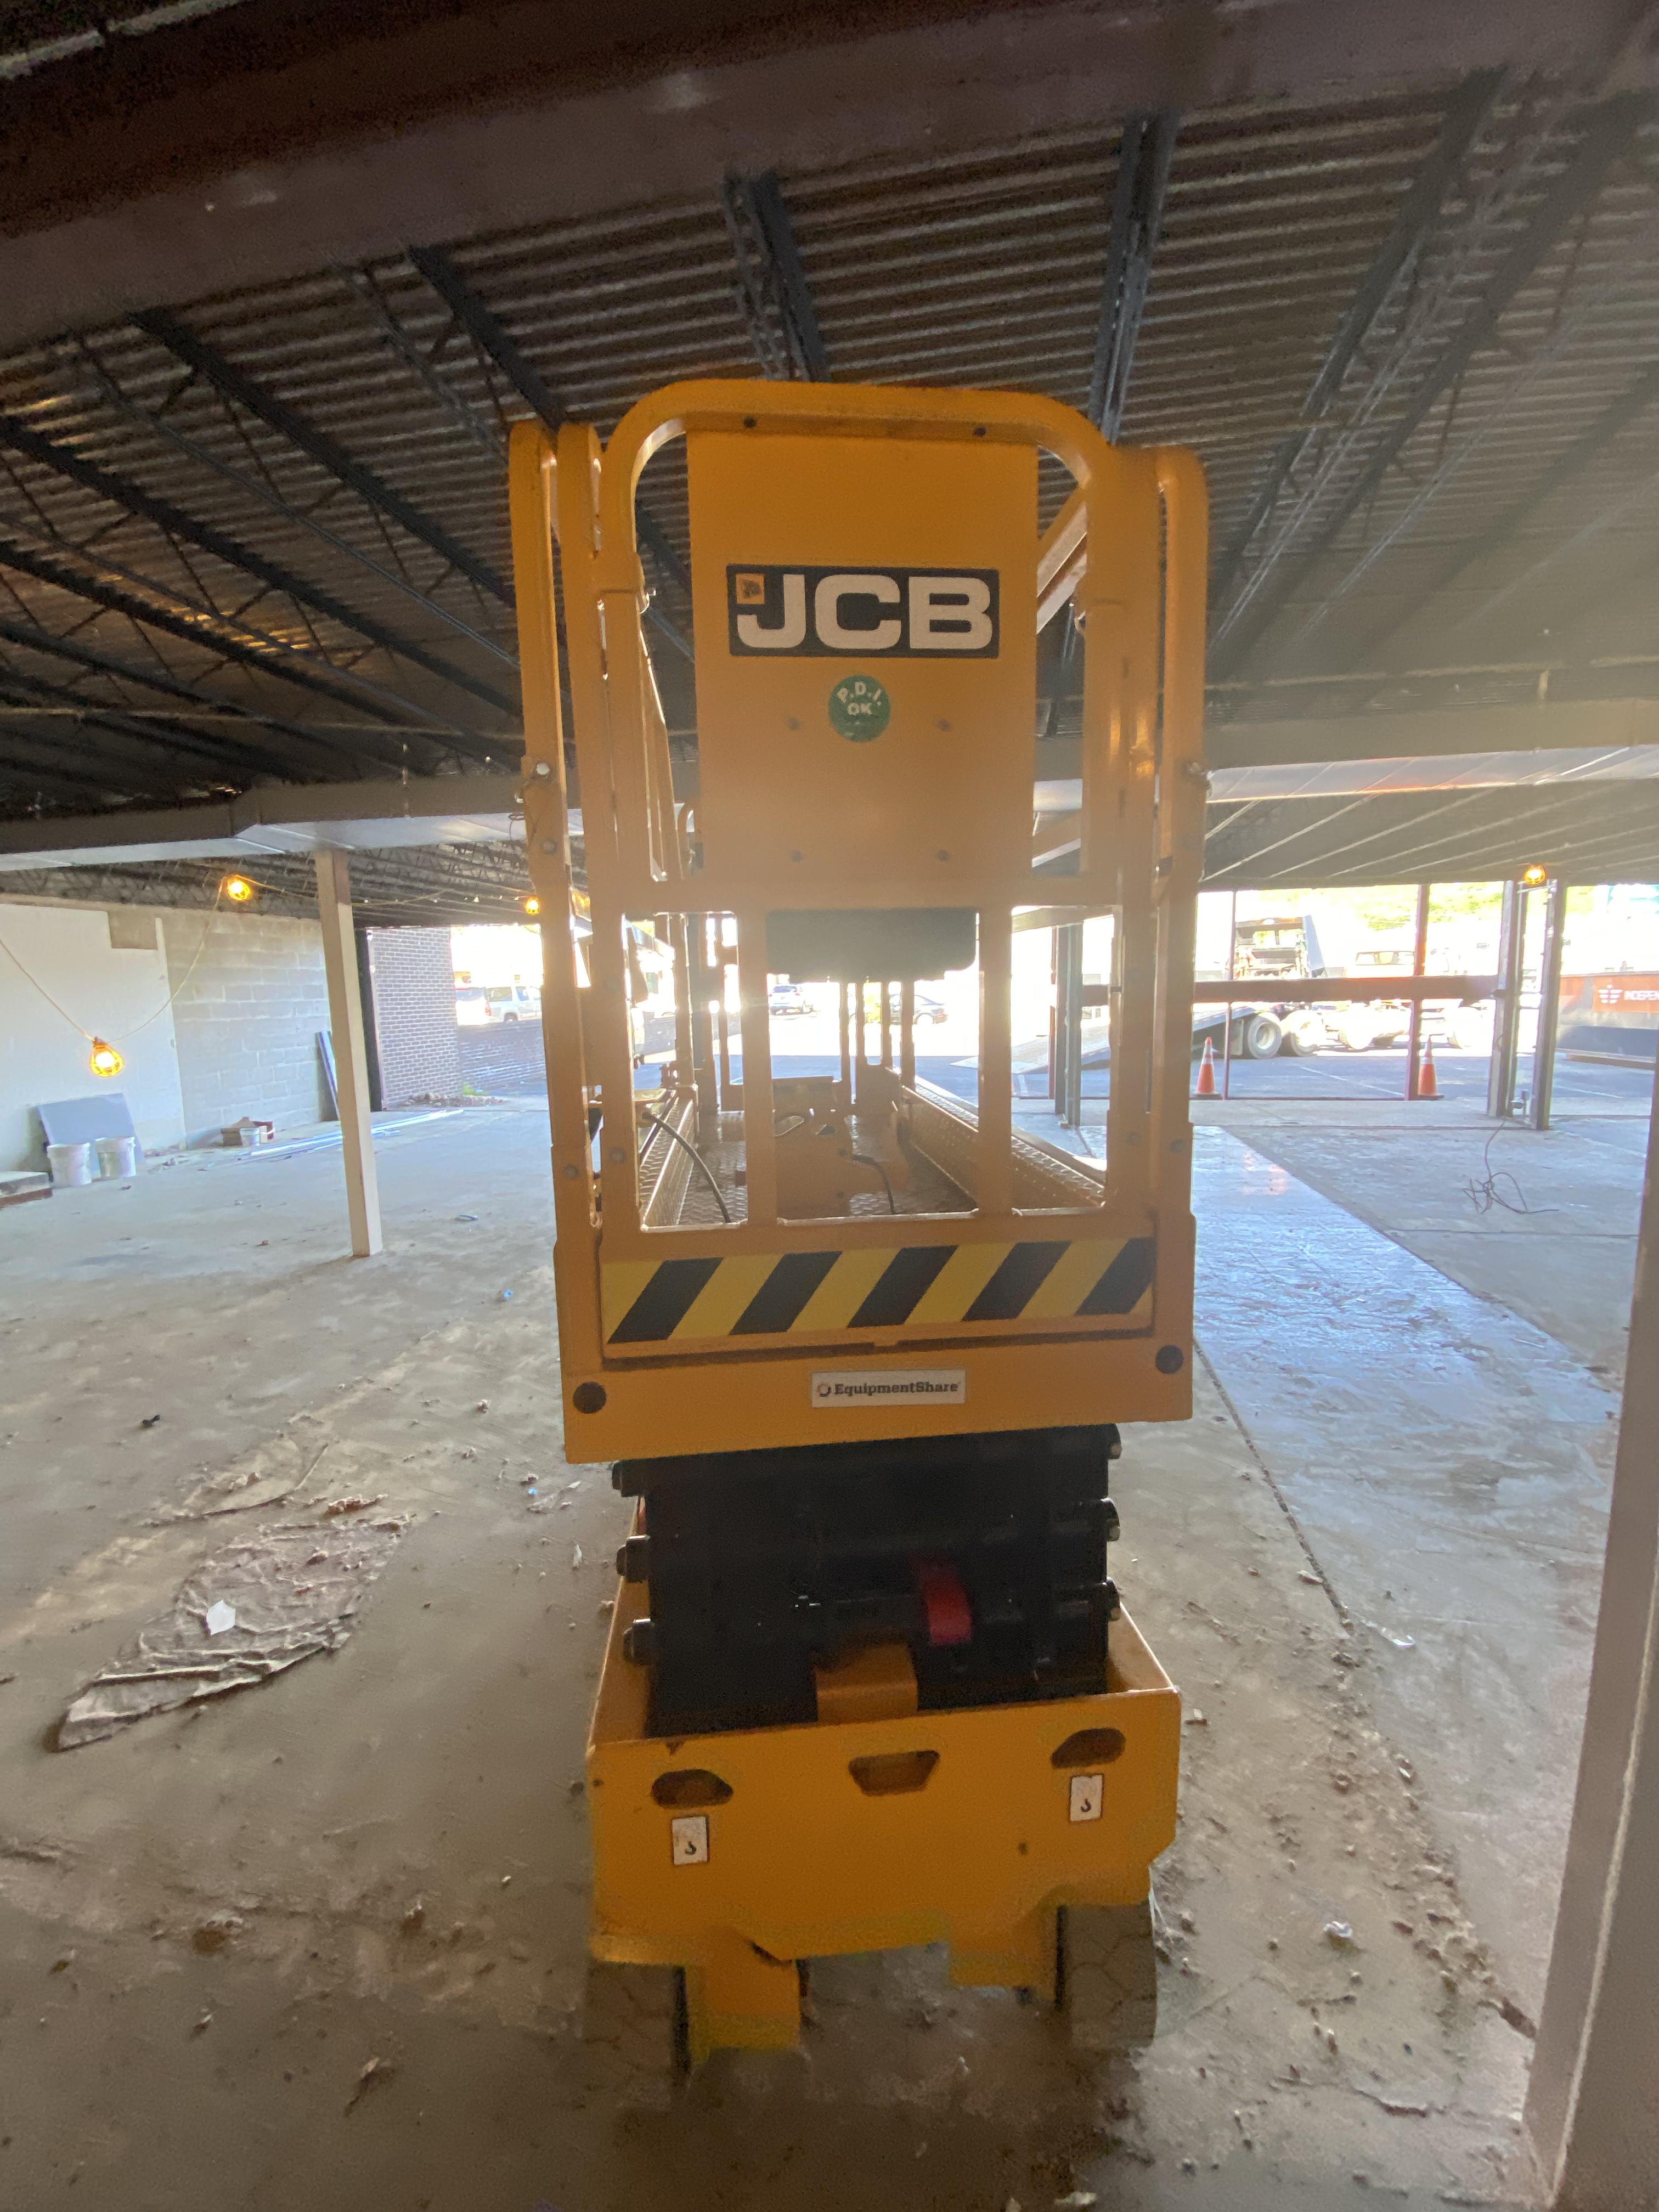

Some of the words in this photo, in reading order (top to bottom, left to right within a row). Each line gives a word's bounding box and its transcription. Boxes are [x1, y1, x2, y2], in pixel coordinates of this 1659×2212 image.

[737, 574, 992, 650] JCB
[848, 702, 873, 715] OK
[834, 1381, 958, 1397] EquipmentShare
